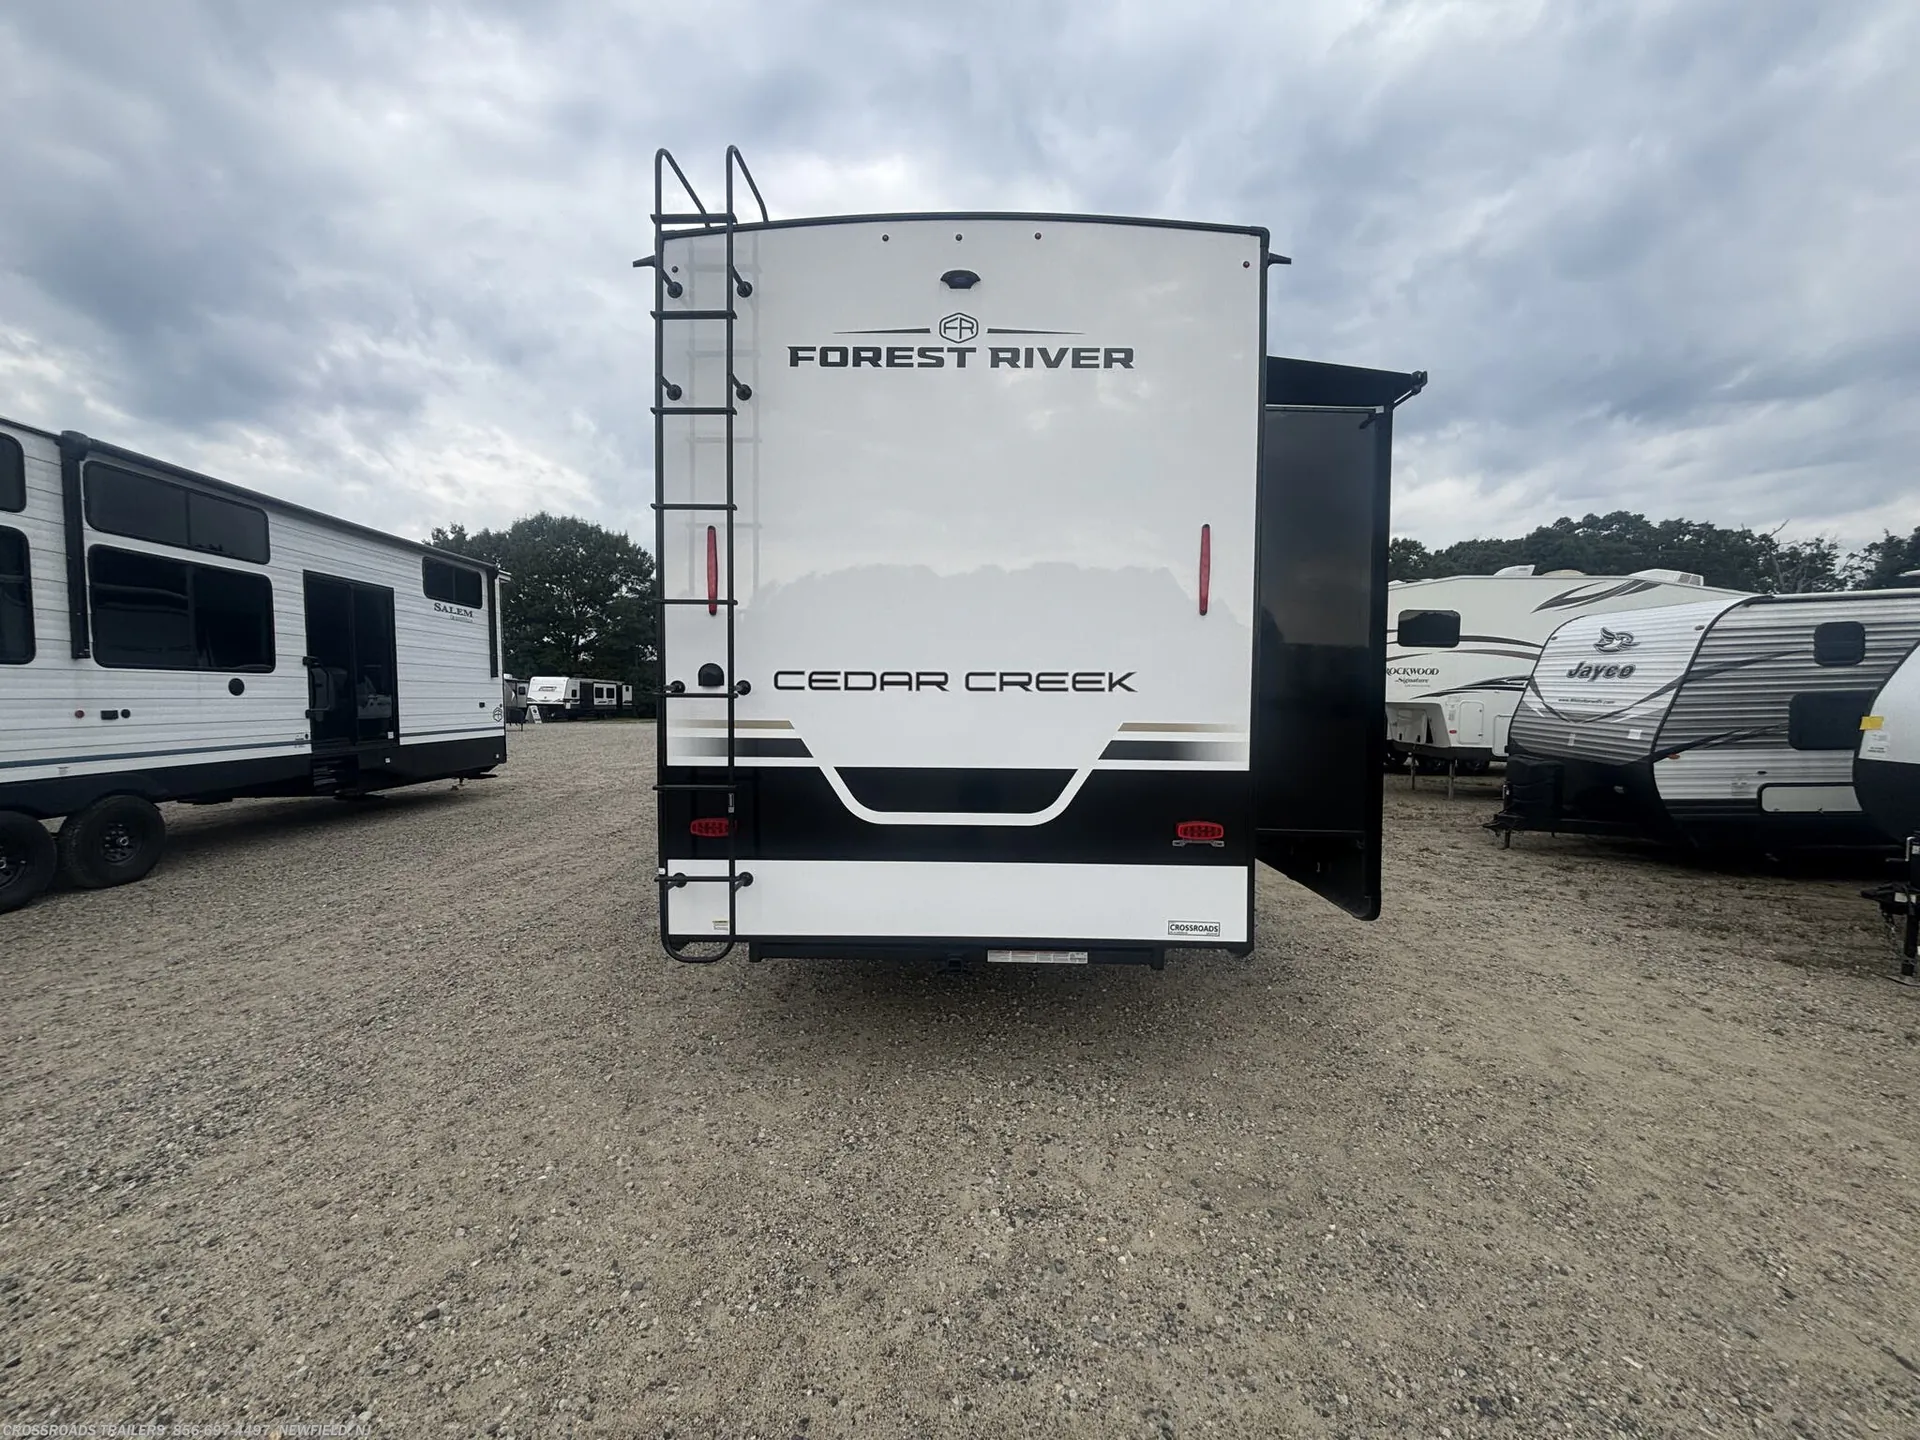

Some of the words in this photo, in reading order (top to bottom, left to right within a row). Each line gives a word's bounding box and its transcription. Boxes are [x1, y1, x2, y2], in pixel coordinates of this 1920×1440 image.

[788, 347, 977, 368] FOREST
[988, 348, 1135, 369] RIVER
[433, 602, 473, 618] SALEM
[774, 671, 950, 692] CEDAR
[964, 671, 1138, 693] CREEK
[1566, 660, 1636, 682] Jayco
[1169, 924, 1219, 932] CROSSROADS
